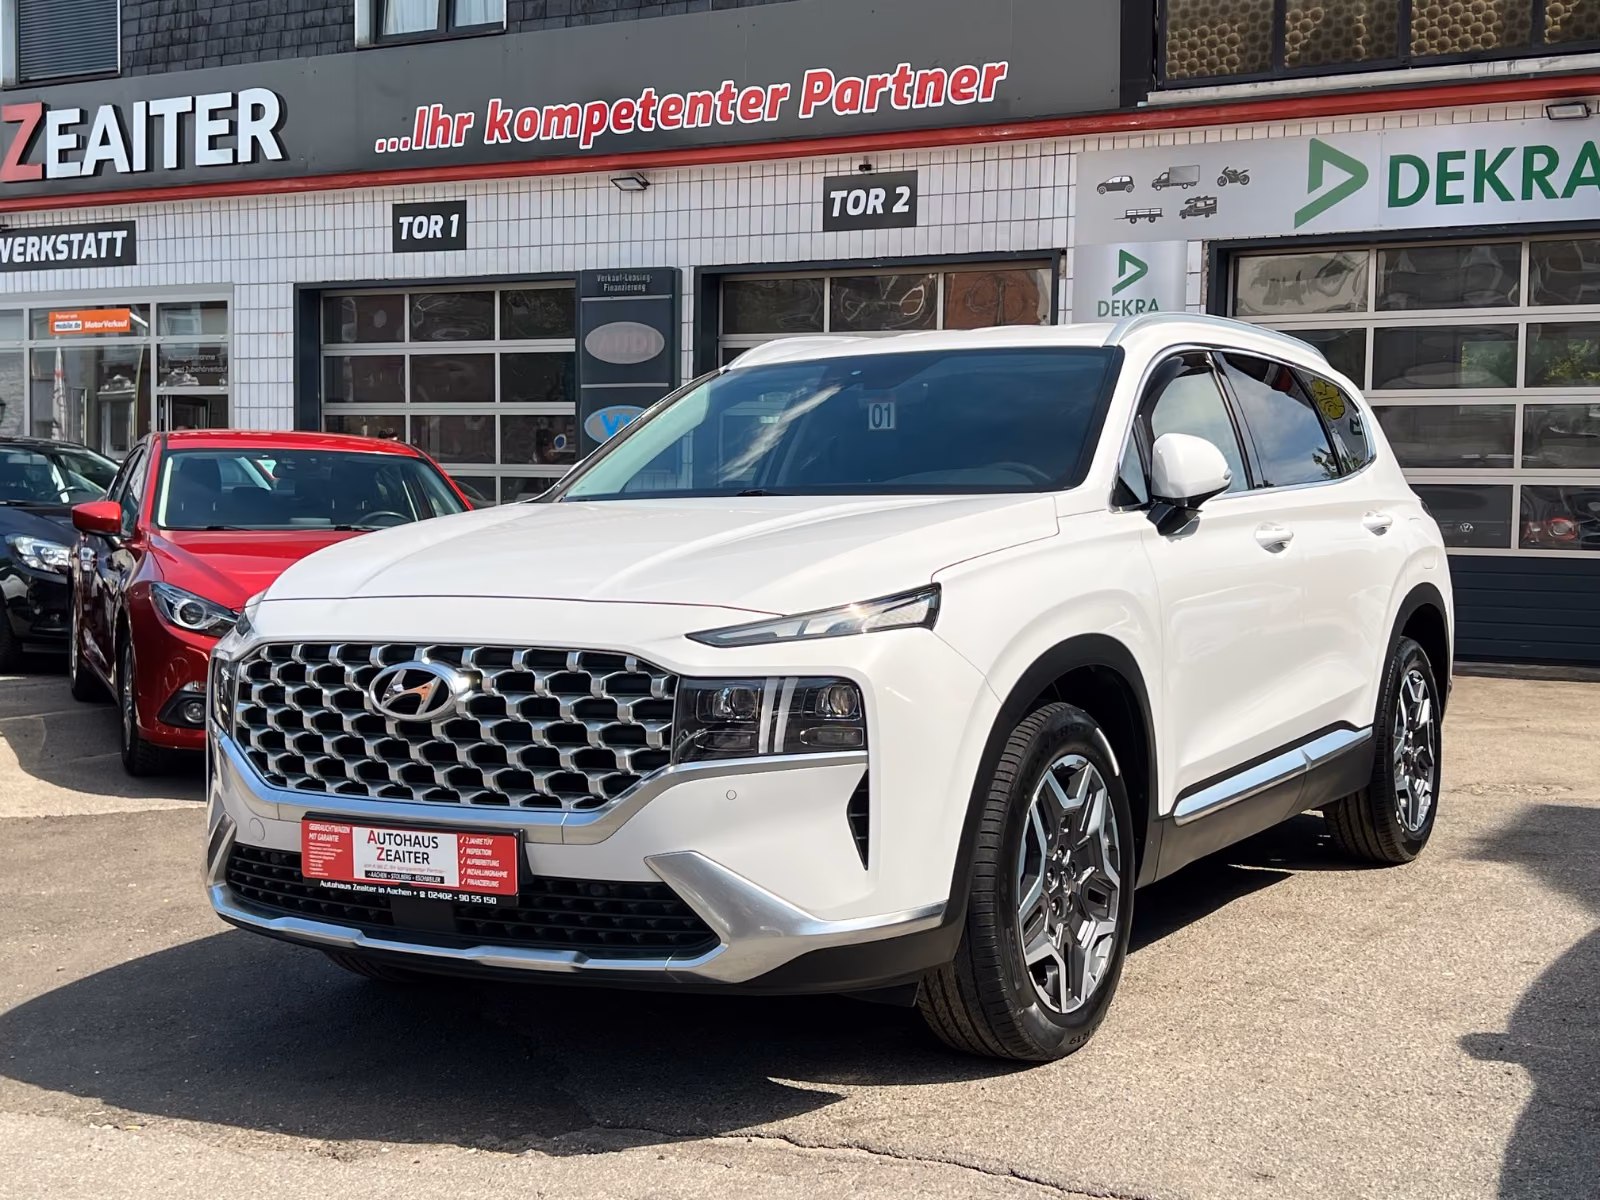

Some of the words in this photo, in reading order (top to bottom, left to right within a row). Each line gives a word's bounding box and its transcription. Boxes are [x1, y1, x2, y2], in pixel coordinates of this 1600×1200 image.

[375, 104, 474, 153] ...Ihr
[484, 80, 790, 149] kompetenter
[799, 61, 1008, 119] Partner
[0, 88, 284, 182] ZEAITER
[1388, 141, 1600, 208] DEKRA
[829, 187, 886, 217] TOR
[892, 185, 911, 214] 2
[399, 214, 444, 240] TOR
[450, 213, 460, 238] 1
[603, 284, 646, 292] Finanzierung
[1097, 298, 1160, 318] DEKRA
[871, 403, 892, 429] 01
[367, 829, 439, 849] AUTOHAUS
[376, 847, 430, 865] ZEAITER
[320, 880, 351, 890] Autohaus
[378, 885, 385, 893] in
[386, 887, 412, 896] Aachen
[428, 891, 452, 900] 02402
